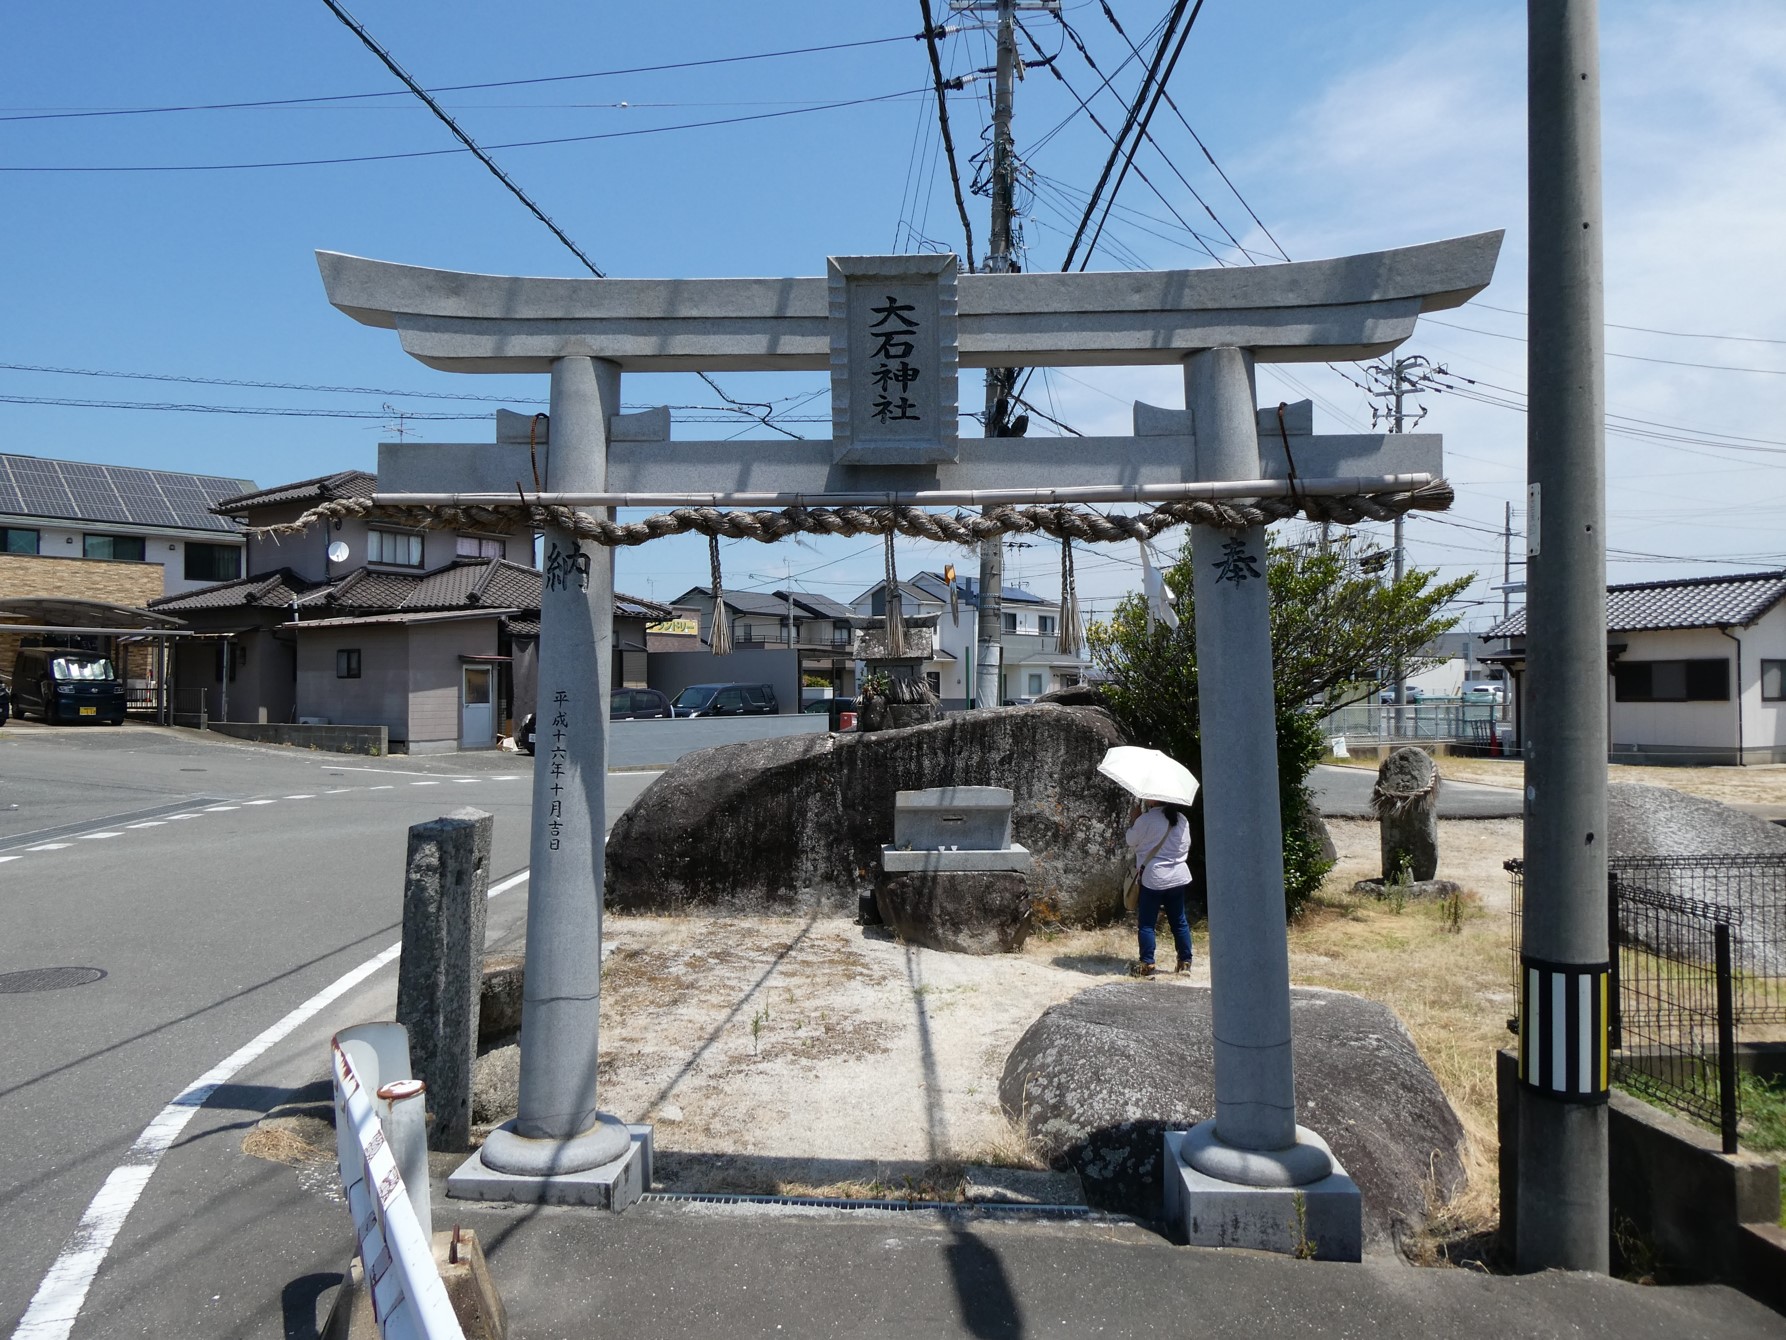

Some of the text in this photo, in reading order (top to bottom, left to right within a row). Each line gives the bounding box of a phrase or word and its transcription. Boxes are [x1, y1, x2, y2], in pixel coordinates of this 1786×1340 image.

[869, 295, 921, 424] 大石神社
[546, 541, 591, 592] 納
[1211, 537, 1262, 590] 奉
[549, 690, 570, 850] 平成十六年十月吉日
